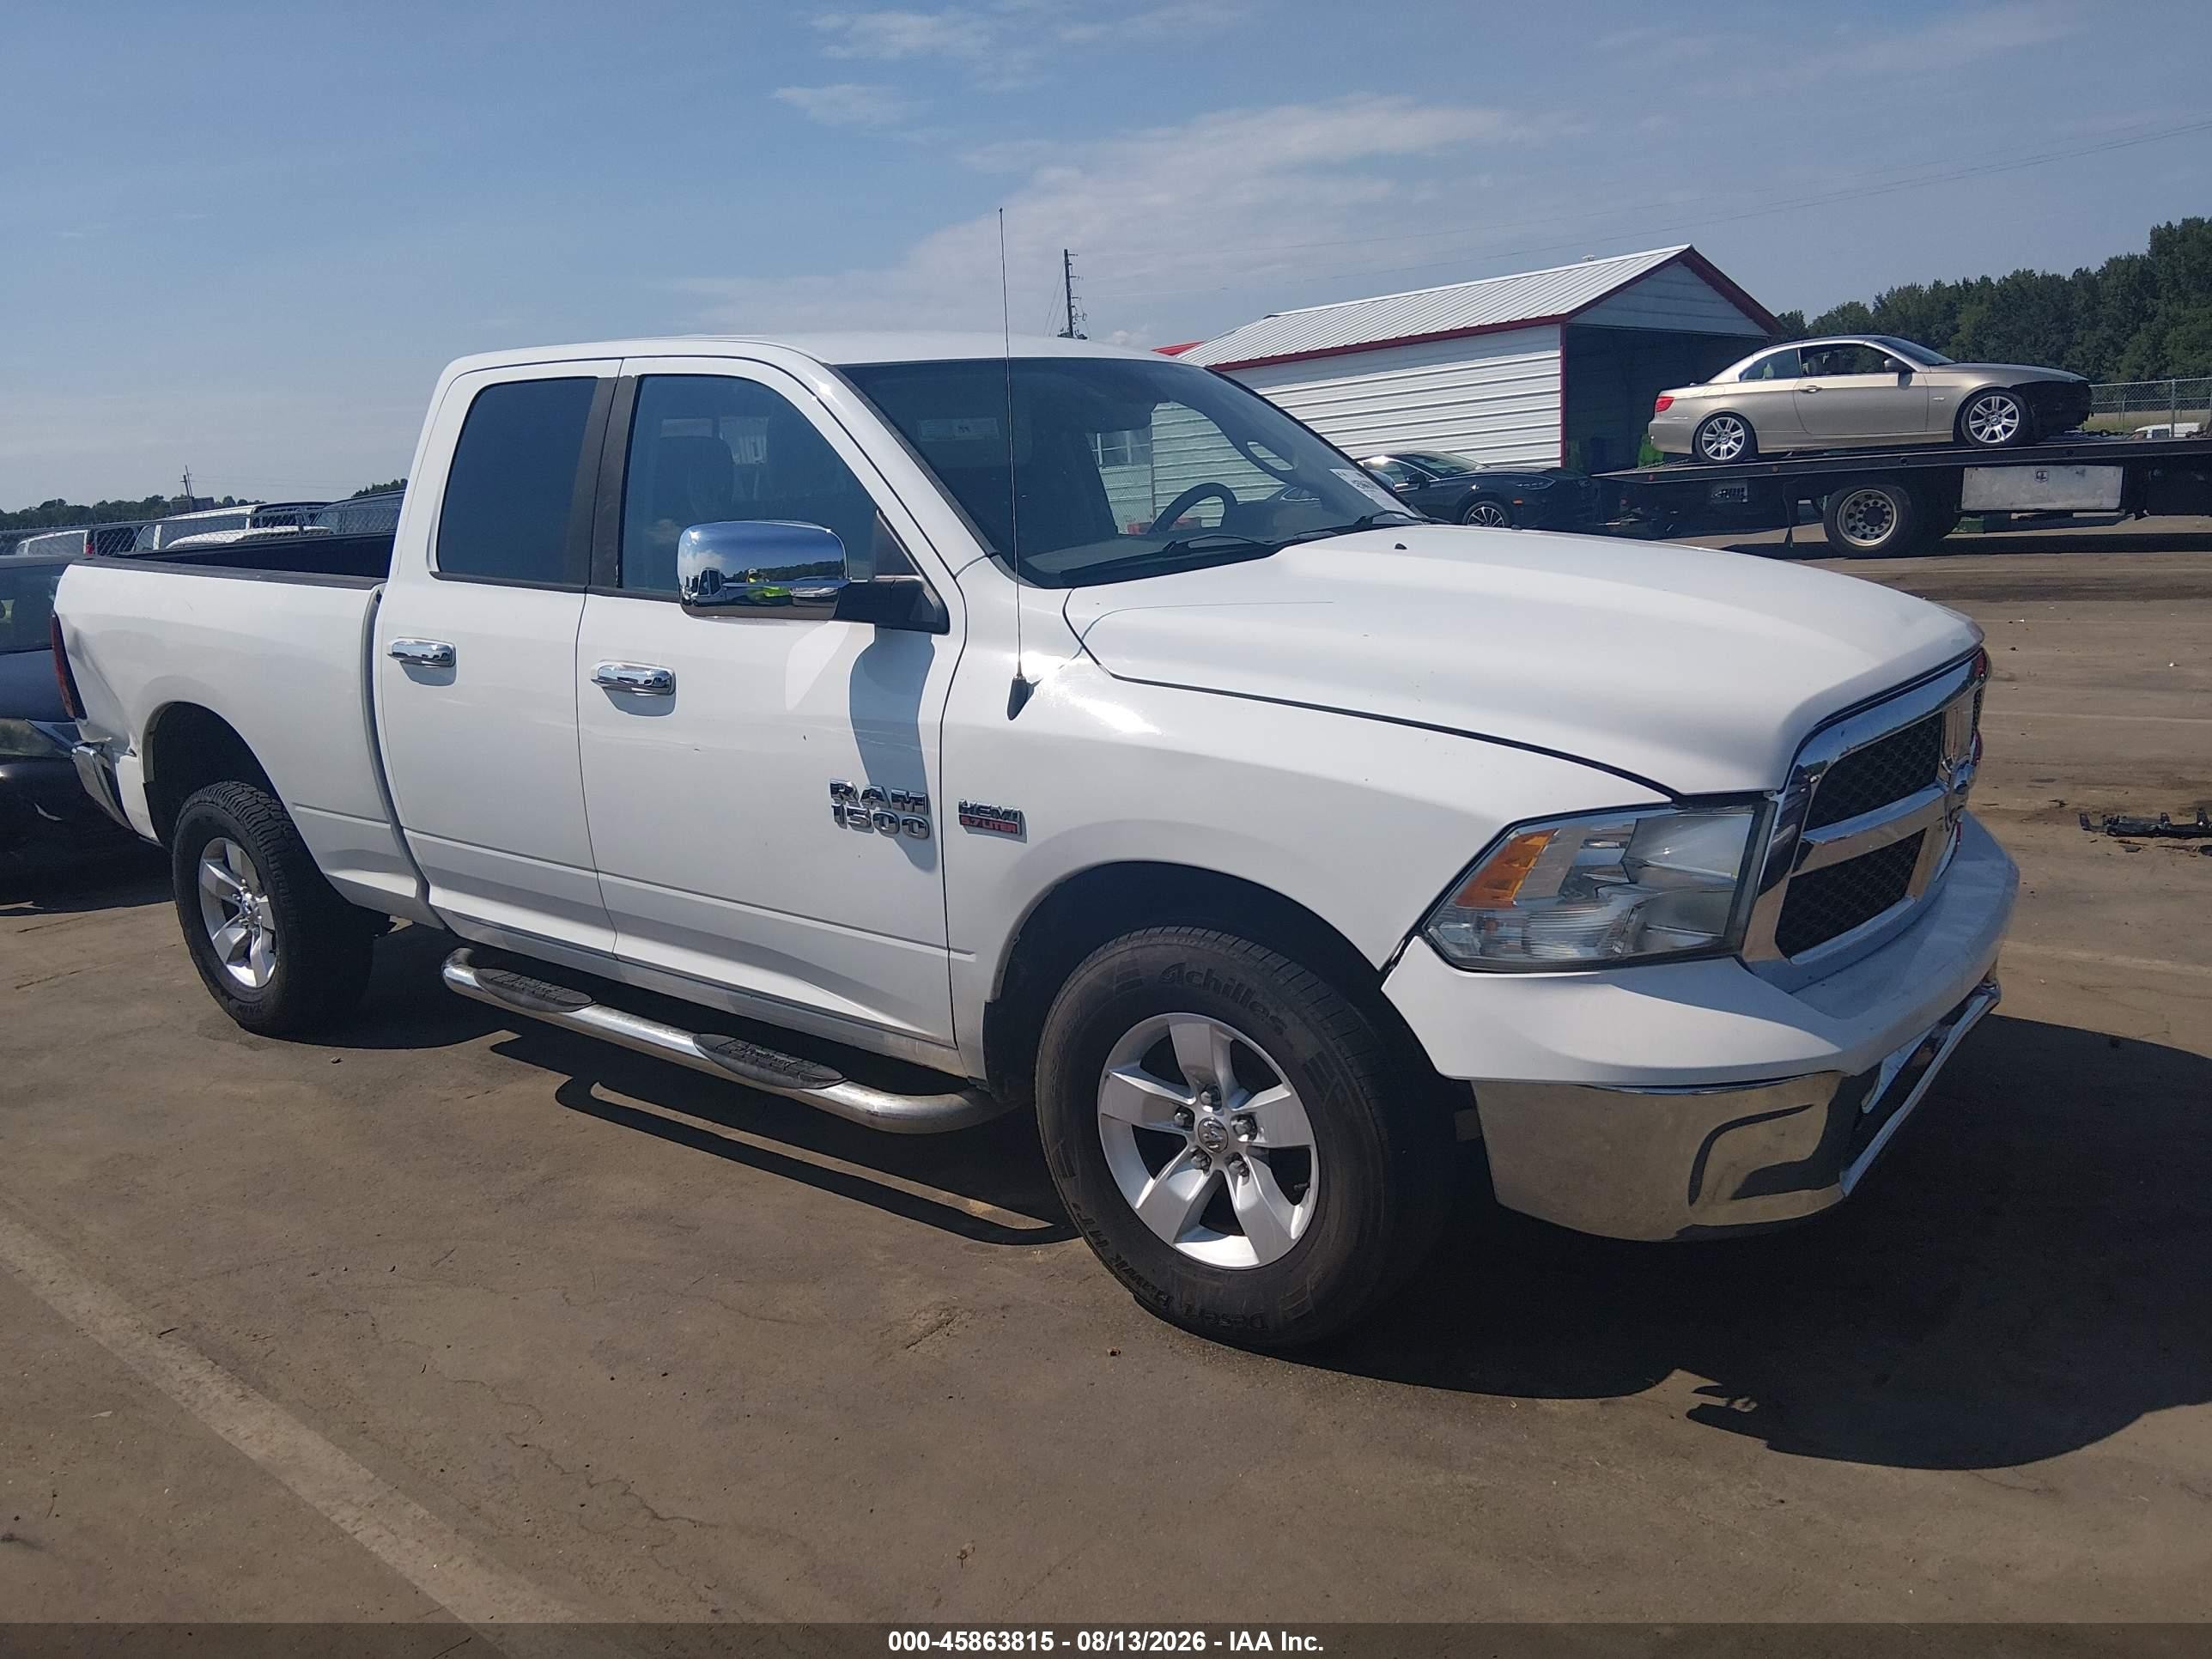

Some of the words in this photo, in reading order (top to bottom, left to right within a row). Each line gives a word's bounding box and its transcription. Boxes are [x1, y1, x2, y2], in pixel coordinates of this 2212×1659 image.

[830, 778, 929, 815] RAM
[957, 798, 1023, 819] HEMI
[830, 803, 931, 839] 1500
[959, 816, 981, 826] 5.7
[981, 817, 1018, 834] LITER
[1158, 961, 1288, 1036] Achilles
